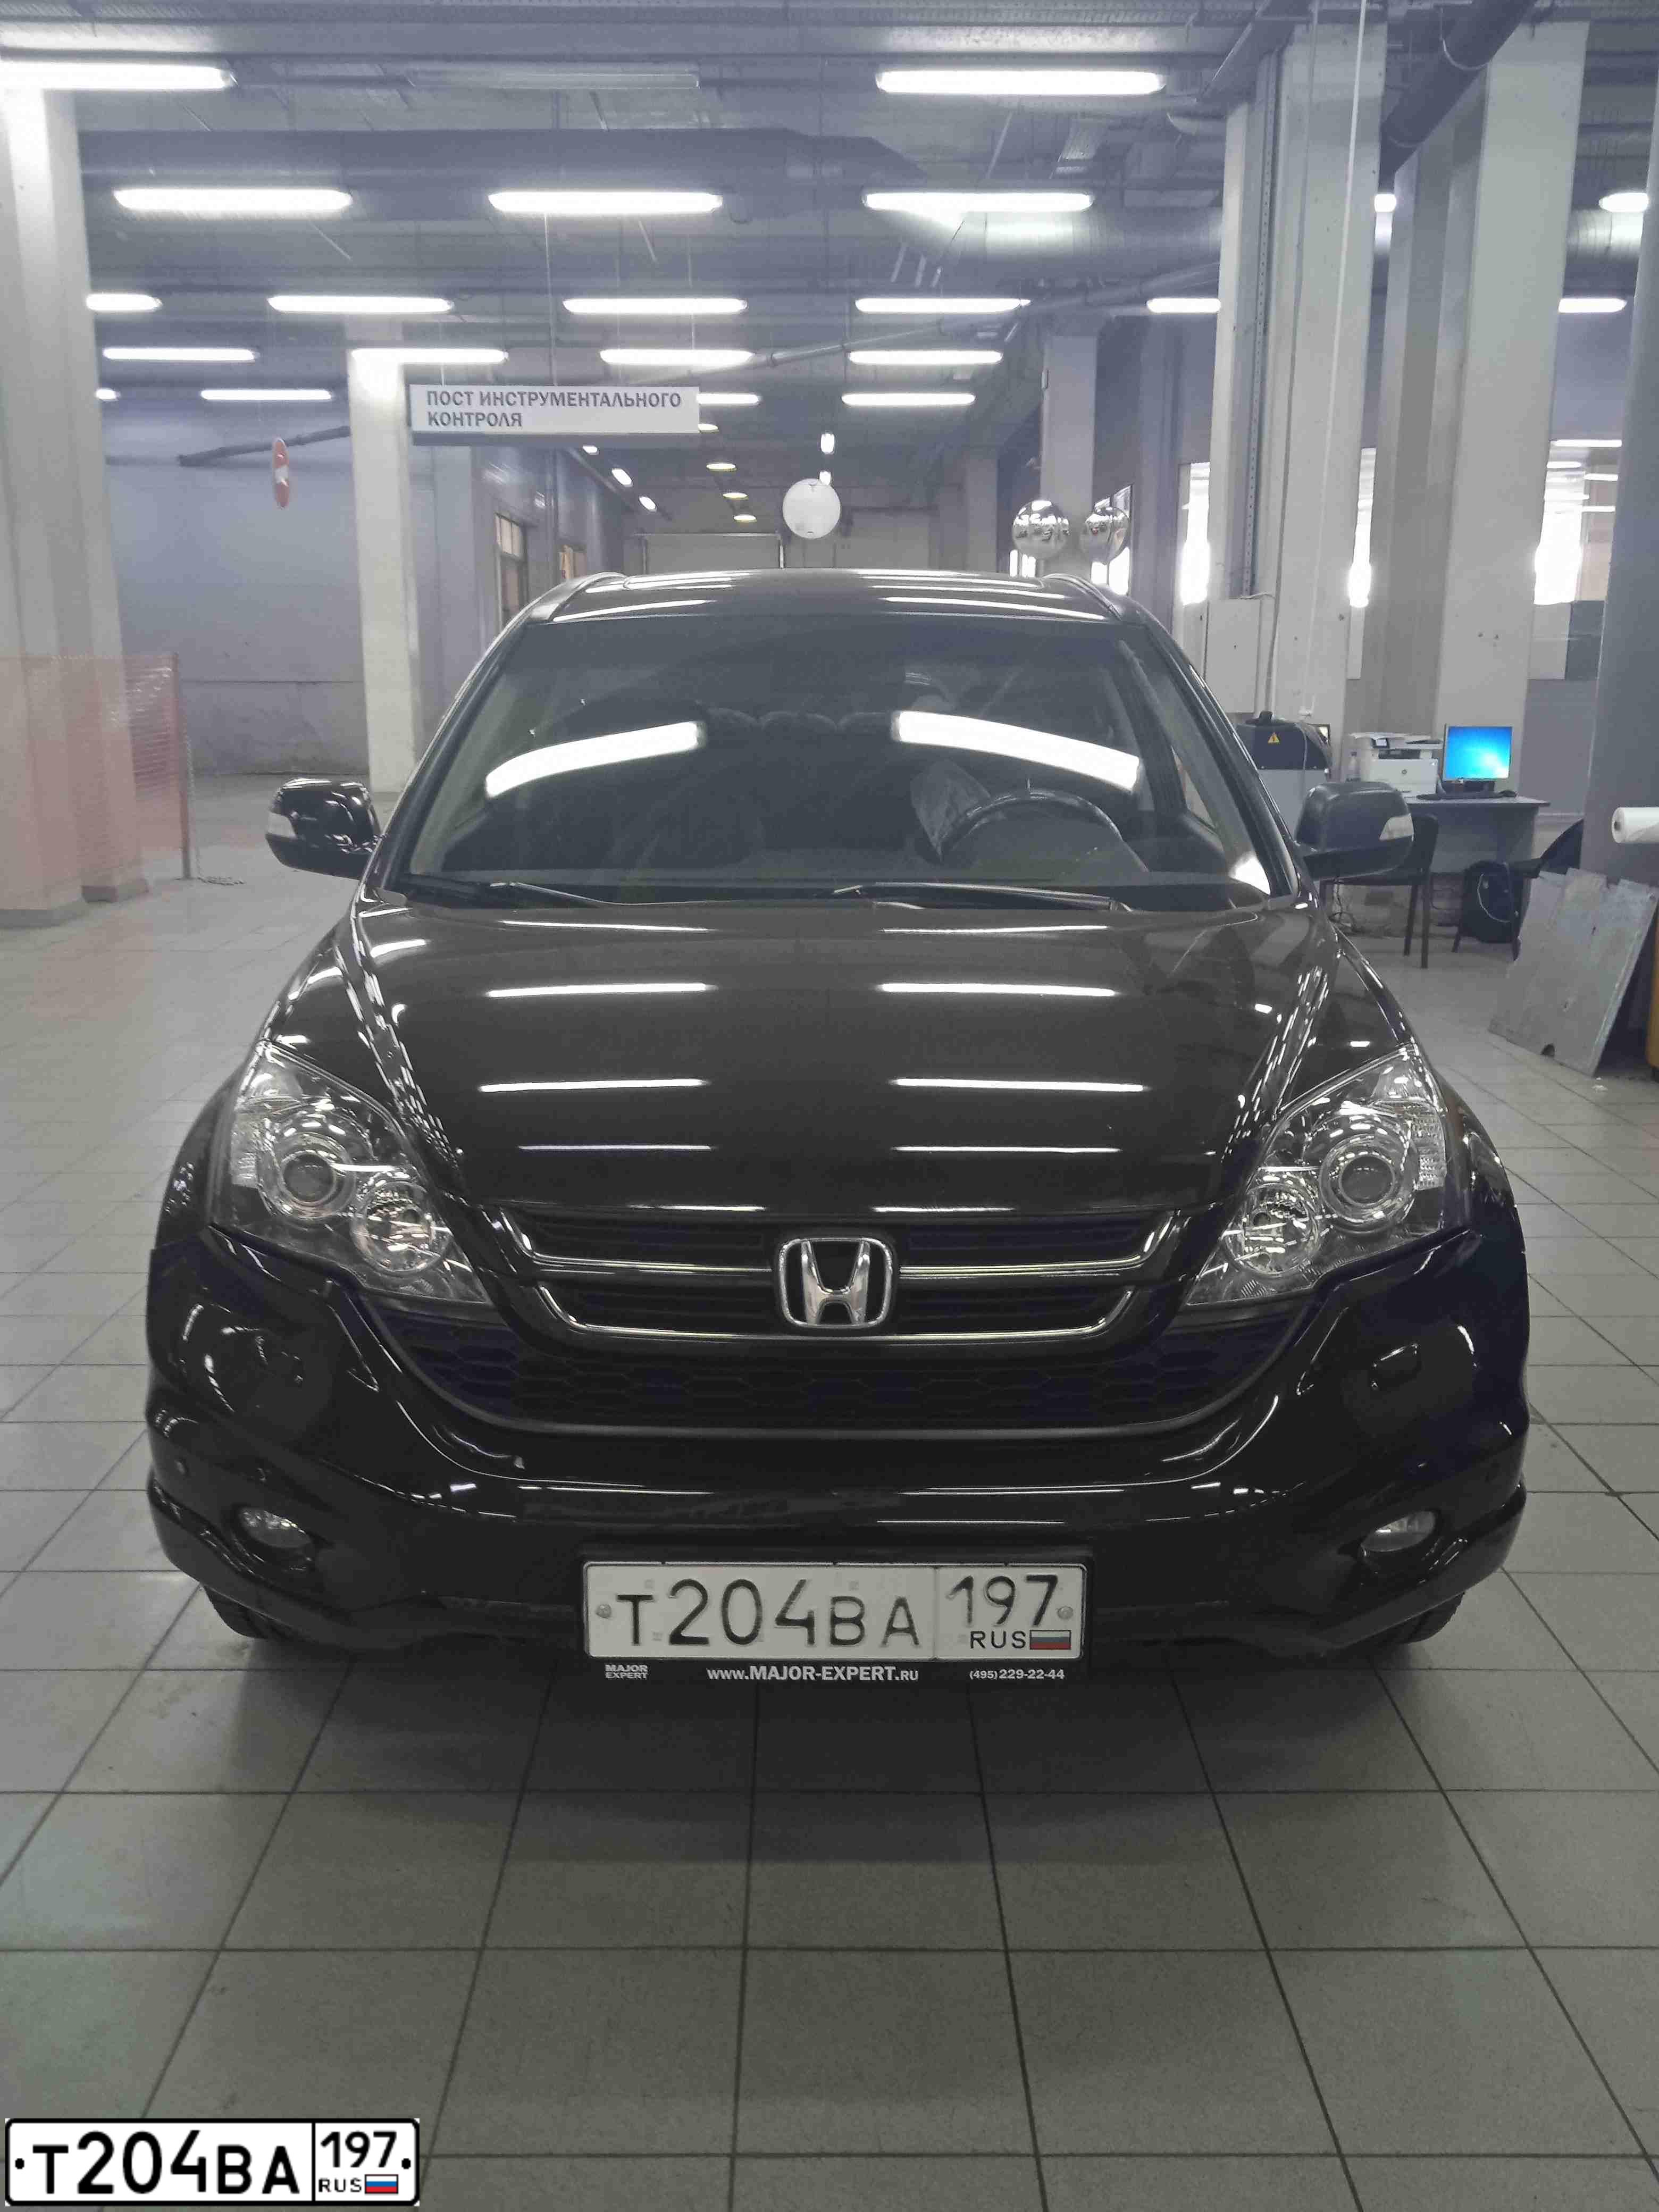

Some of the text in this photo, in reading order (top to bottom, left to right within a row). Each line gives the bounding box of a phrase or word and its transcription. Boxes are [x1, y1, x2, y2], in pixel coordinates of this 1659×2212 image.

[427, 391, 681, 407] ПОСТ ИНСТРУМЕНТАЛЬНОГО
[428, 412, 522, 427] КОНТРОЛЯ
[946, 1574, 1059, 1626] 197
[970, 1630, 1026, 1649] RUS
